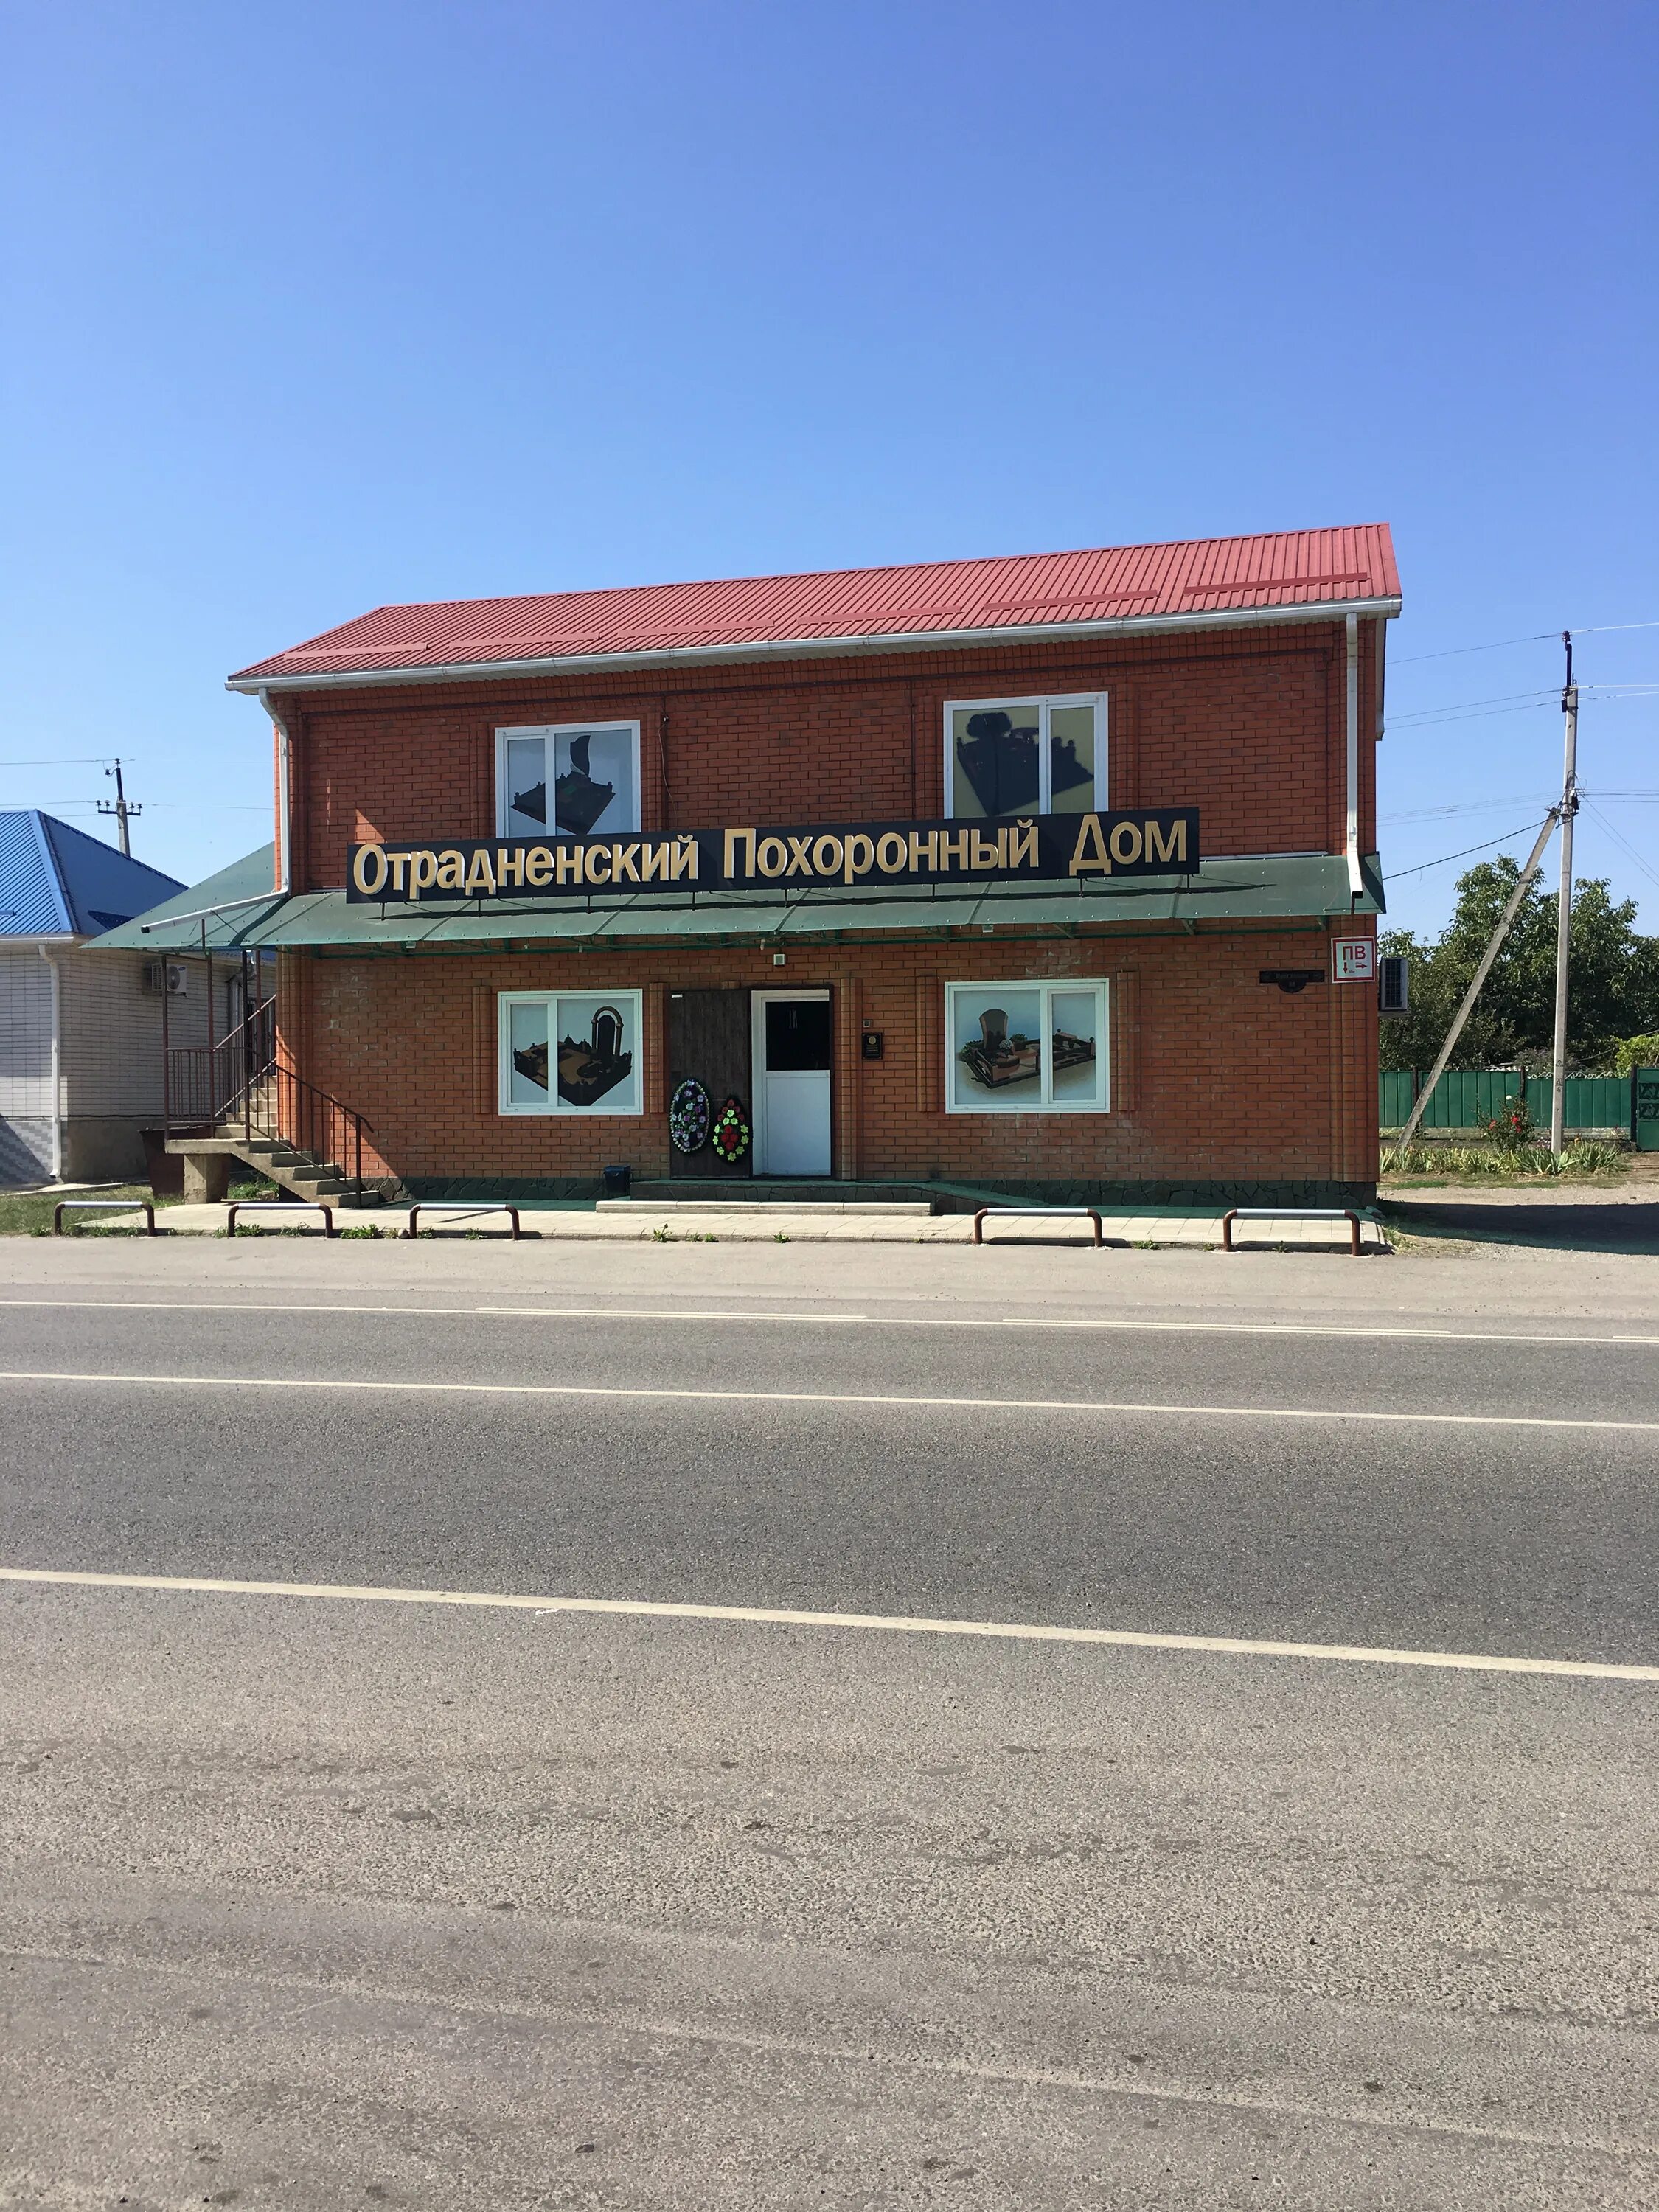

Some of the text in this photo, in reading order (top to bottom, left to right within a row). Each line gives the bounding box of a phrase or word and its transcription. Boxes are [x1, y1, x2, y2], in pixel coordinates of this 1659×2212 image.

[353, 814, 1186, 900] Отрадненский Похоронный Дом
[1343, 945, 1366, 960] ПВ
